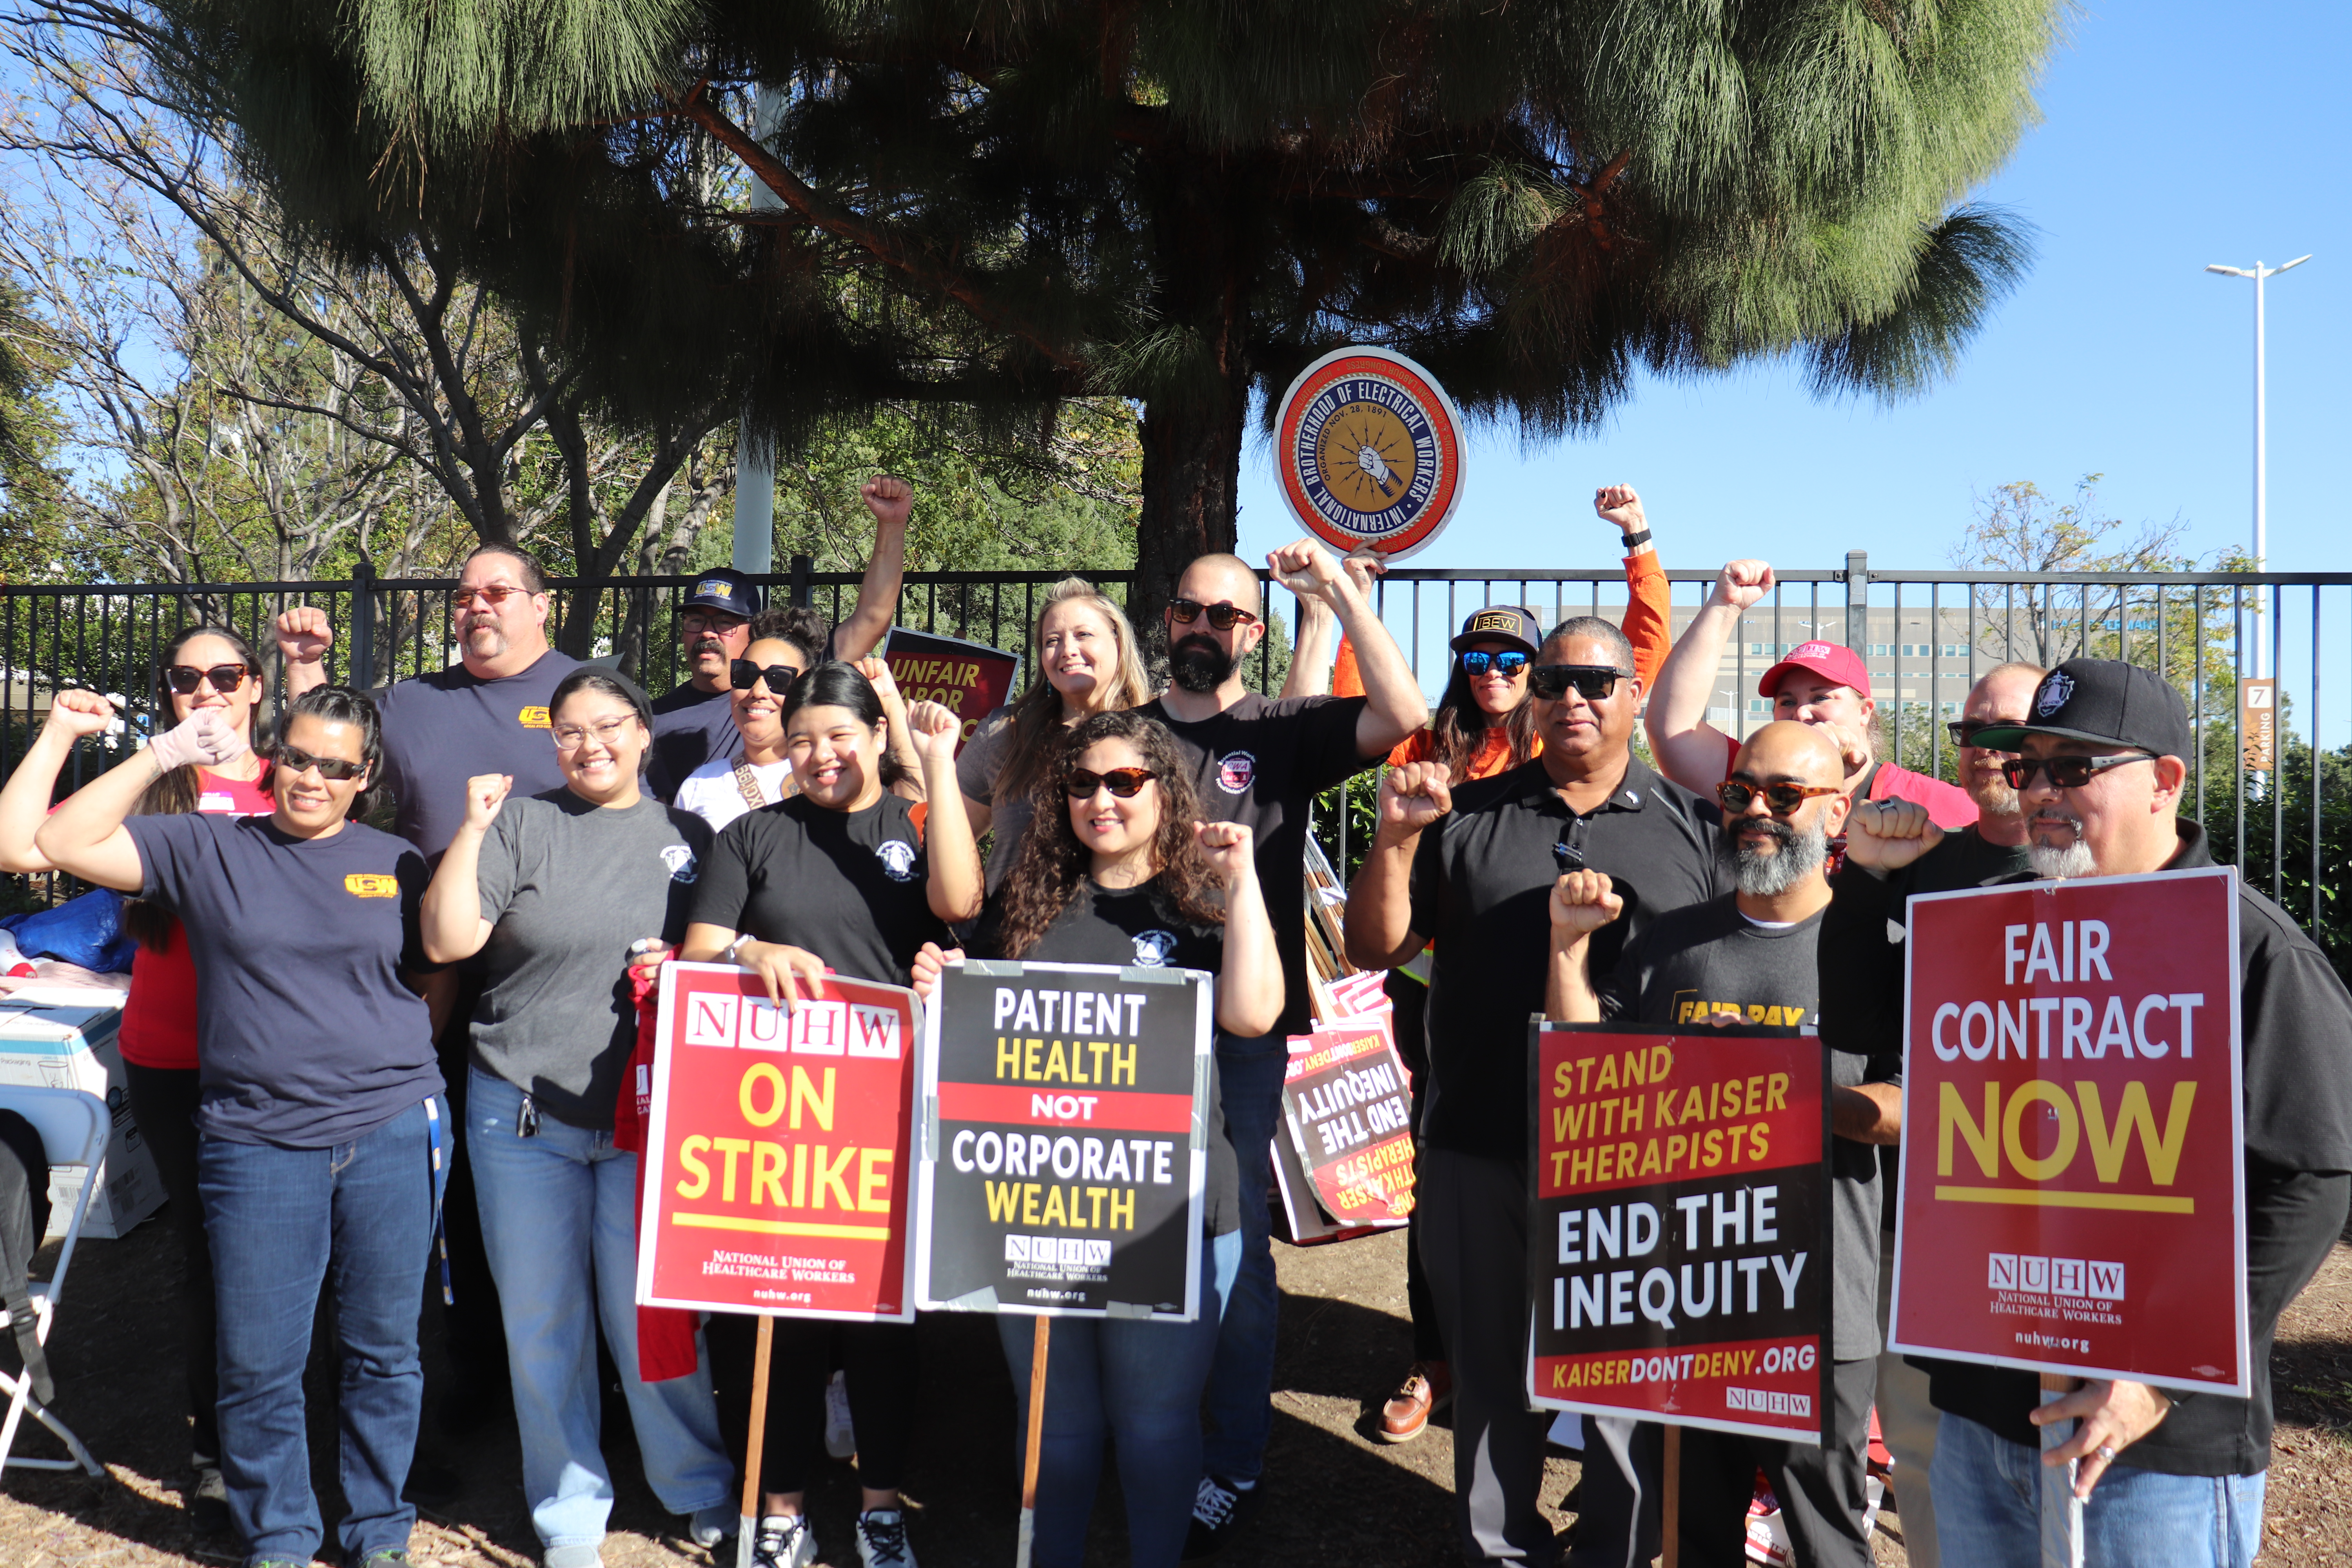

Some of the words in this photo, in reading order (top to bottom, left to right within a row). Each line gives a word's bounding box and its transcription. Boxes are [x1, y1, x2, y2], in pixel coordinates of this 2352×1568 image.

[1346, 360, 1387, 372] CONGRESS
[1388, 365, 1419, 391] LABOUR
[1289, 383, 1316, 421] AFFILIATED
[1315, 370, 1332, 386] WITH
[1337, 384, 1352, 404] OF
[1358, 381, 1424, 434] ELECTRICAL
[1416, 385, 1447, 426] CANADIAN
[1283, 434, 1293, 478] AMERICAN
[1300, 394, 1336, 486] BROTHERHOOD
[1320, 428, 1330, 481] ORGANIZED
[1330, 409, 1348, 428] NOV.
[1351, 405, 1364, 414] 28,
[1367, 405, 1387, 418] 1891
[1409, 435, 1434, 503] WORKERS
[1441, 434, 1454, 501] ORGANIZATIONS
[1289, 479, 1316, 524] FEDERATION
[1314, 486, 1407, 532] INTERNATIONAL
[1315, 522, 1325, 532] OF
[1325, 529, 1349, 548] LABOR
[1399, 536, 1408, 546] OF
[1409, 504, 1444, 541] INDUSTRIAL
[695, 583, 733, 597] USW
[1479, 618, 1515, 629] IBEW
[892, 659, 980, 688] UNFAIR
[518, 709, 552, 722] US
[900, 686, 964, 713] ABOR
[2253, 689, 2266, 705] 7
[2260, 712, 2271, 762] PARKING
[1217, 750, 1241, 766] Essential
[1227, 762, 1248, 770] CWA
[1215, 777, 1227, 792] Proud
[1240, 775, 1256, 793] Member
[344, 878, 398, 894] USW
[2004, 919, 2113, 985] FAIR
[692, 1000, 895, 1050] NUHW
[994, 987, 1146, 1037] PATIENT
[1747, 1004, 1805, 1026] PAY
[1931, 992, 2205, 1063] CONTRACT
[996, 1036, 1137, 1085] HEALTH
[1553, 1044, 1673, 1098] STAND
[739, 1062, 836, 1131] ON
[1032, 1094, 1097, 1120] NOT
[1298, 1062, 1397, 1125] INEQUITY
[1552, 1093, 1645, 1143] WITH
[1653, 1071, 1791, 1129] KAISER
[1317, 1110, 1369, 1156] THE
[1368, 1095, 1409, 1135] END
[1936, 1078, 2198, 1187] NOW
[675, 1134, 893, 1213] STRIKE
[952, 1129, 1173, 1183] CORPORATE
[1336, 1136, 1416, 1186] HERAPISTS
[1550, 1122, 1771, 1189] THERAPISTS
[1392, 1162, 1416, 1189] ITH
[985, 1180, 1135, 1230] WEALTH
[1557, 1200, 1661, 1265] END
[1675, 1185, 1779, 1252] THE
[713, 1250, 777, 1267] NATIONAL
[782, 1256, 826, 1269] UNION
[828, 1259, 847, 1271] OF
[1009, 1239, 1107, 1261] NUHW
[1013, 1261, 1058, 1272] NATIONAL
[1059, 1264, 1089, 1274] UNION
[702, 1261, 788, 1279] HEALTHCARE
[791, 1269, 855, 1284] WORKERS
[1007, 1267, 1063, 1280] HEALTHCARE
[1066, 1272, 1109, 1282] WORKERS
[1553, 1251, 1808, 1331] INEQUITY
[1993, 1258, 2122, 1294] NUHW
[753, 1287, 811, 1303] nuhw.org
[1027, 1287, 1086, 1302] nuhw.org
[1990, 1301, 2059, 1319] HEALTHCARE
[2063, 1308, 2122, 1325] WORKERS
[1998, 1290, 2051, 1306] NATIONAL
[2054, 1296, 2094, 1310] UNION
[2097, 1301, 2113, 1312] OF
[2015, 1331, 2090, 1353] nuhw.org
[1552, 1344, 1816, 1388] KAISERDONTDENY.ORG
[1729, 1389, 1810, 1414] NUHW
